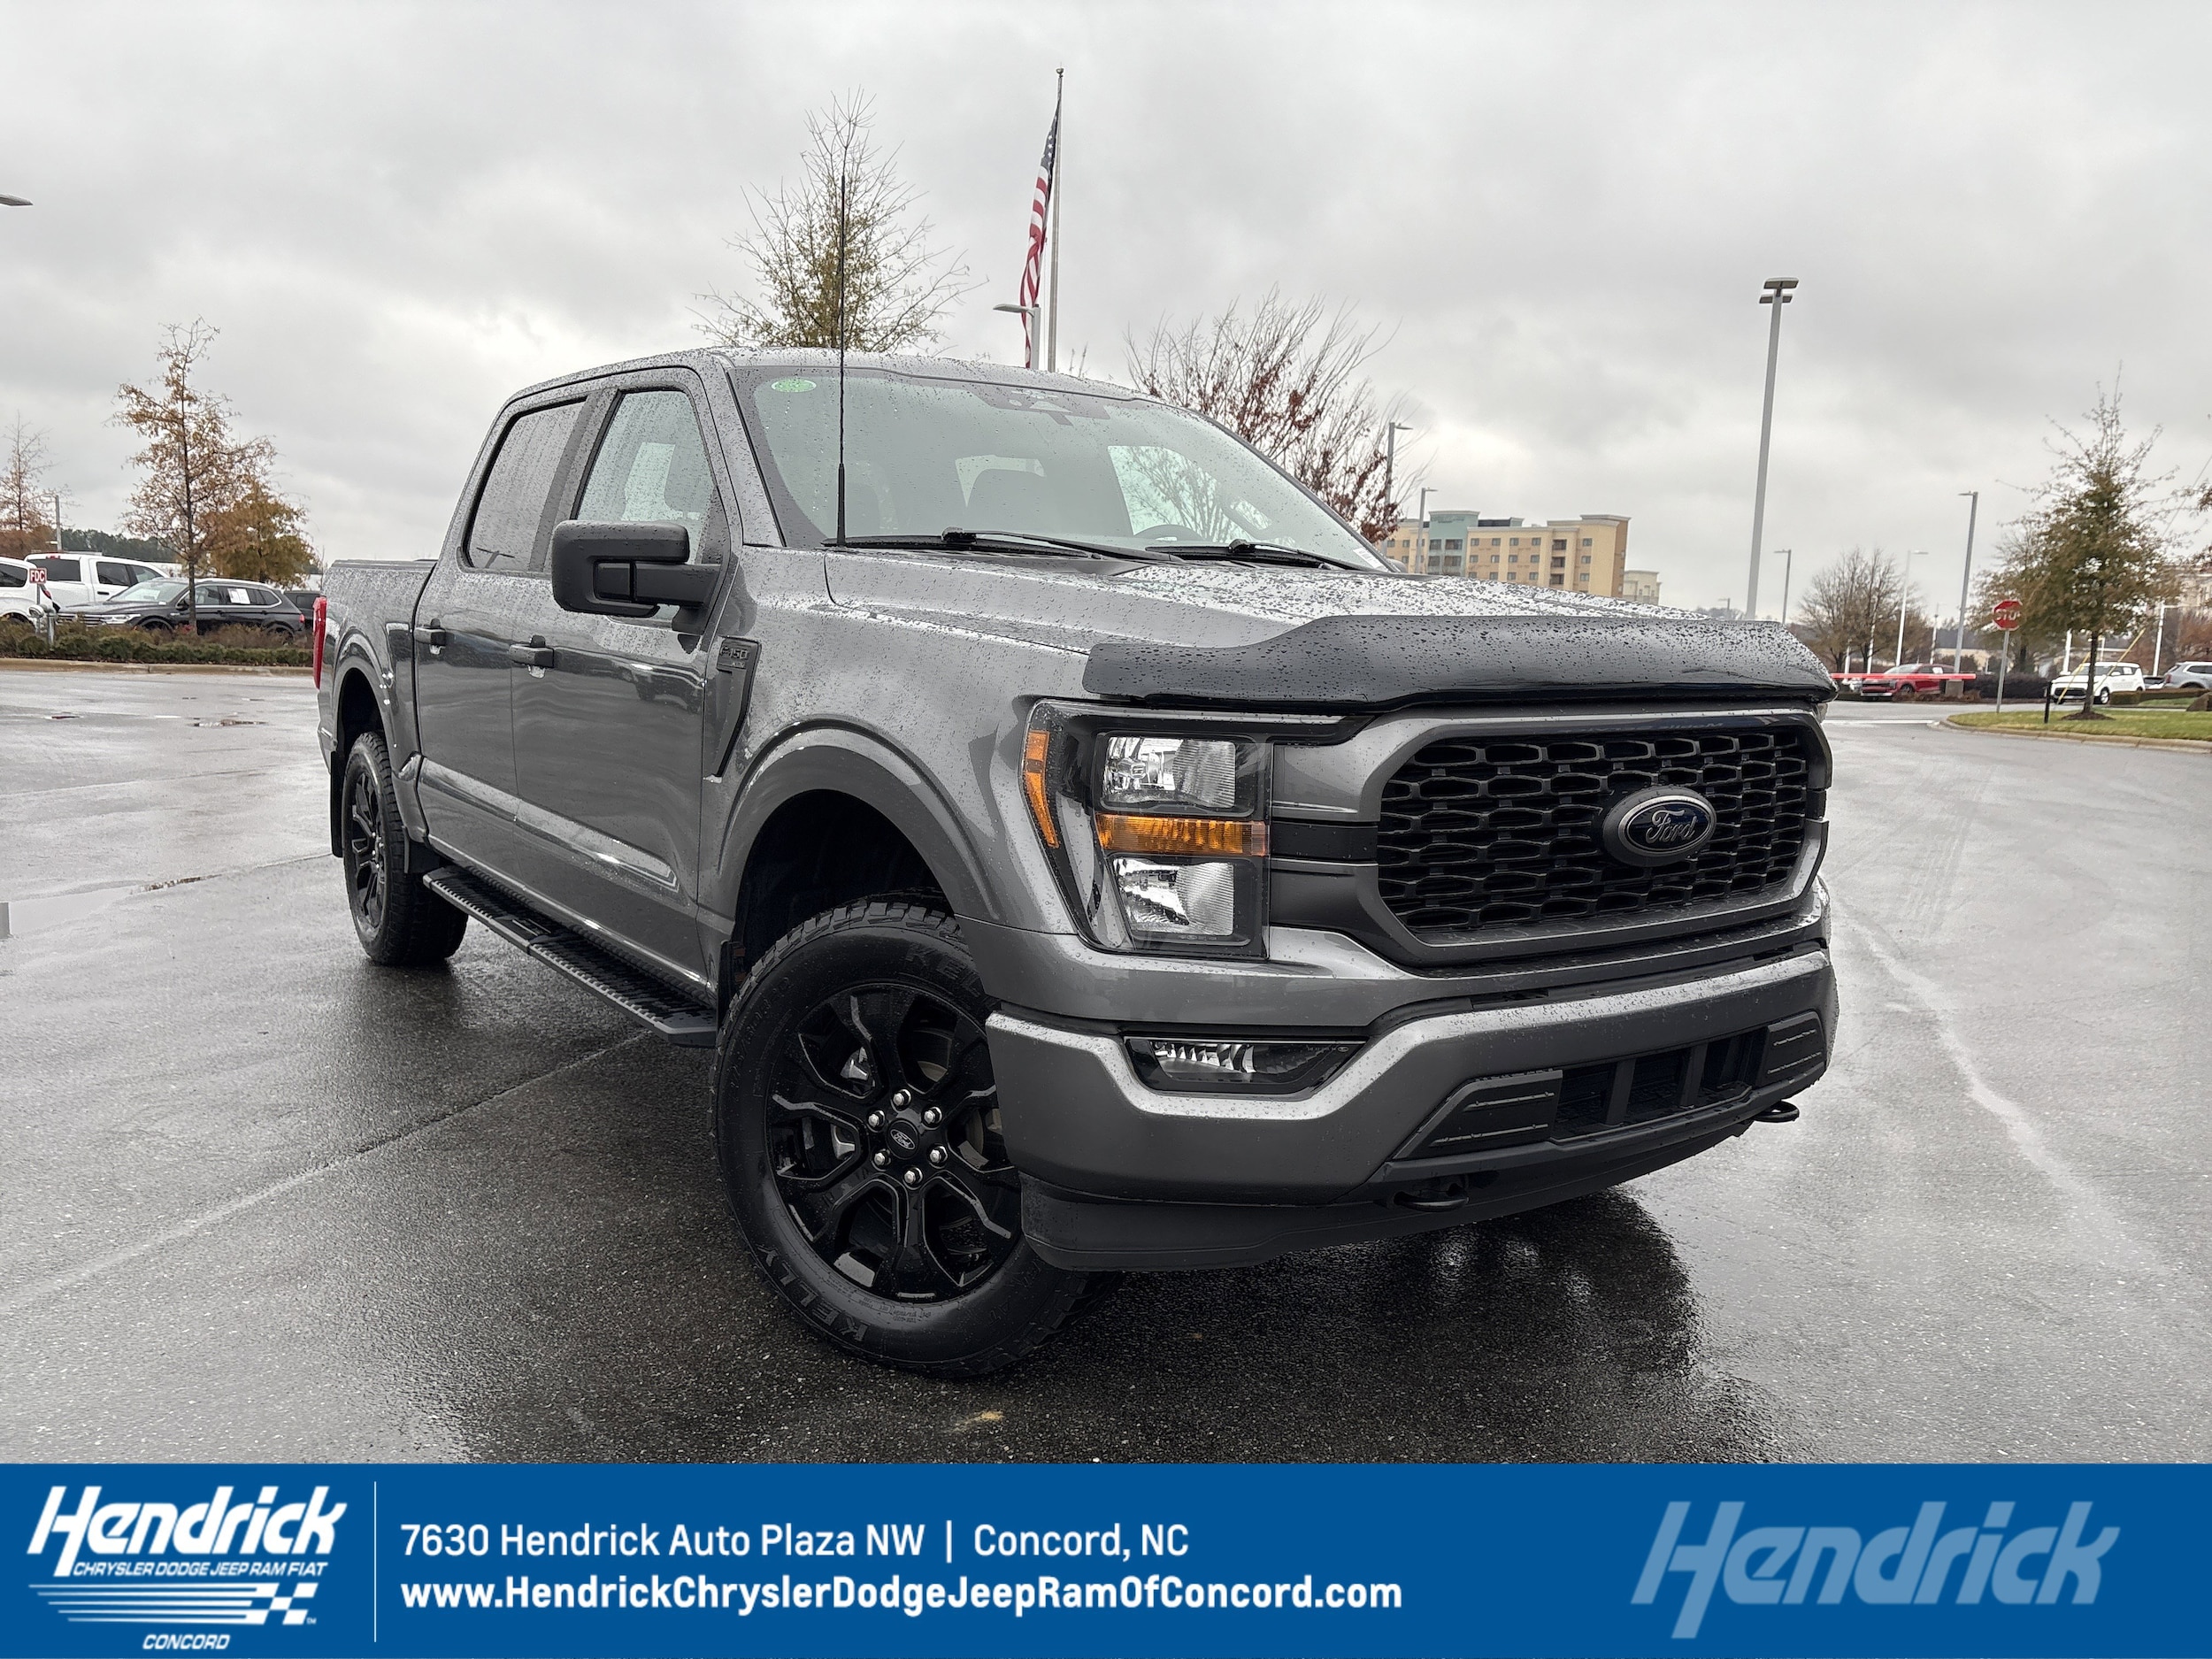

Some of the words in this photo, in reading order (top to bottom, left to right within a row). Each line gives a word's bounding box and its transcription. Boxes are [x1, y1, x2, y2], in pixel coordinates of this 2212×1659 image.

[30, 570, 45, 582] FDC
[1646, 809, 1698, 844] Ford
[894, 1133, 911, 1148] Ford
[756, 1244, 871, 1342] KELLY
